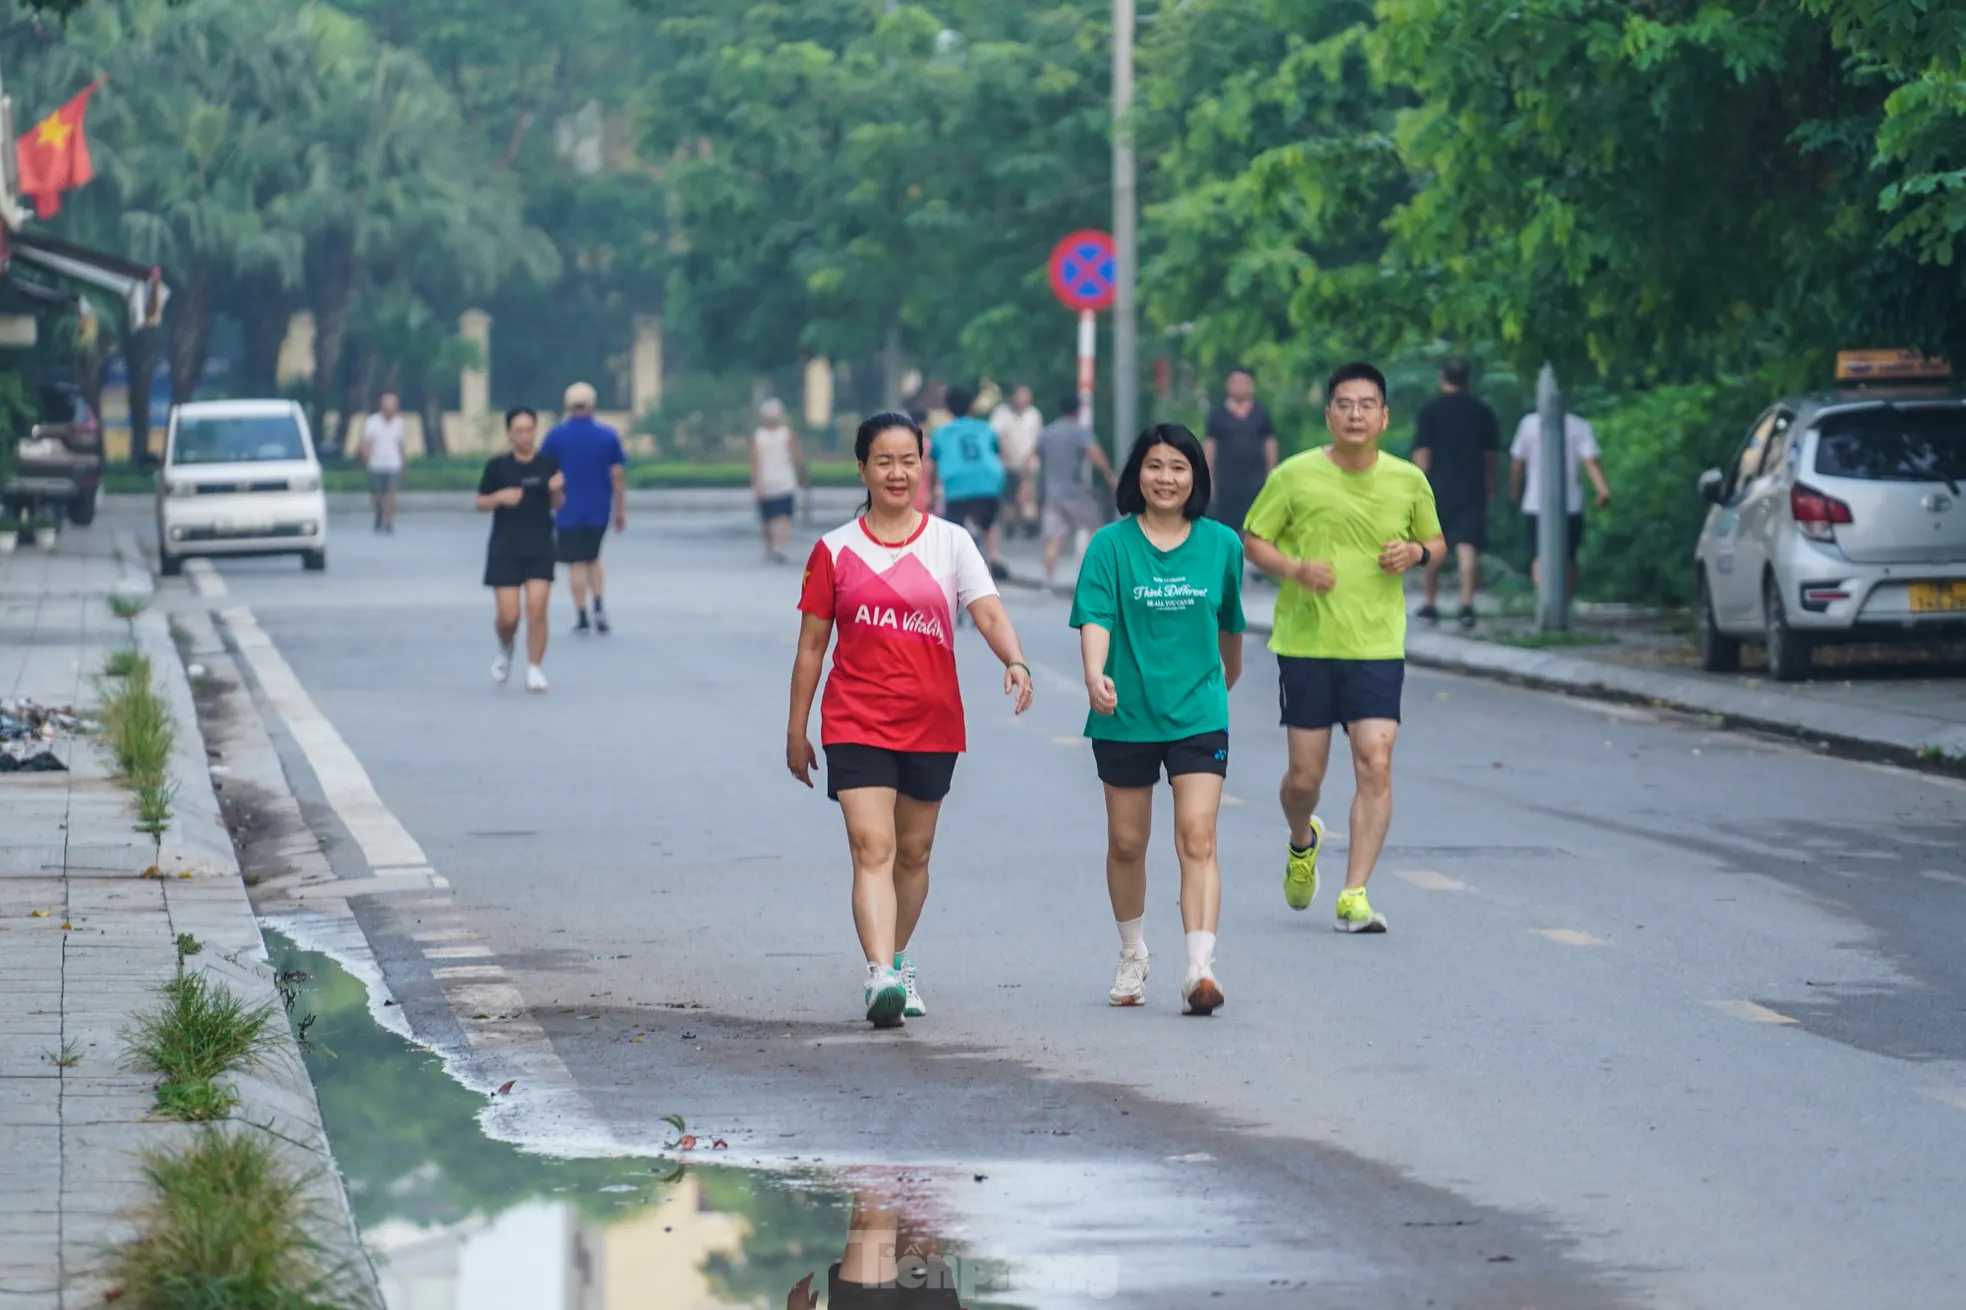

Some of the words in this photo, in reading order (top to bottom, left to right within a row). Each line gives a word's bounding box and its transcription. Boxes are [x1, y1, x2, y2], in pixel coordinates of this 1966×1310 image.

[1133, 585, 1162, 600] Think
[1164, 584, 1208, 597] Different
[855, 604, 898, 629] AIA
[902, 610, 944, 645] Vitality
